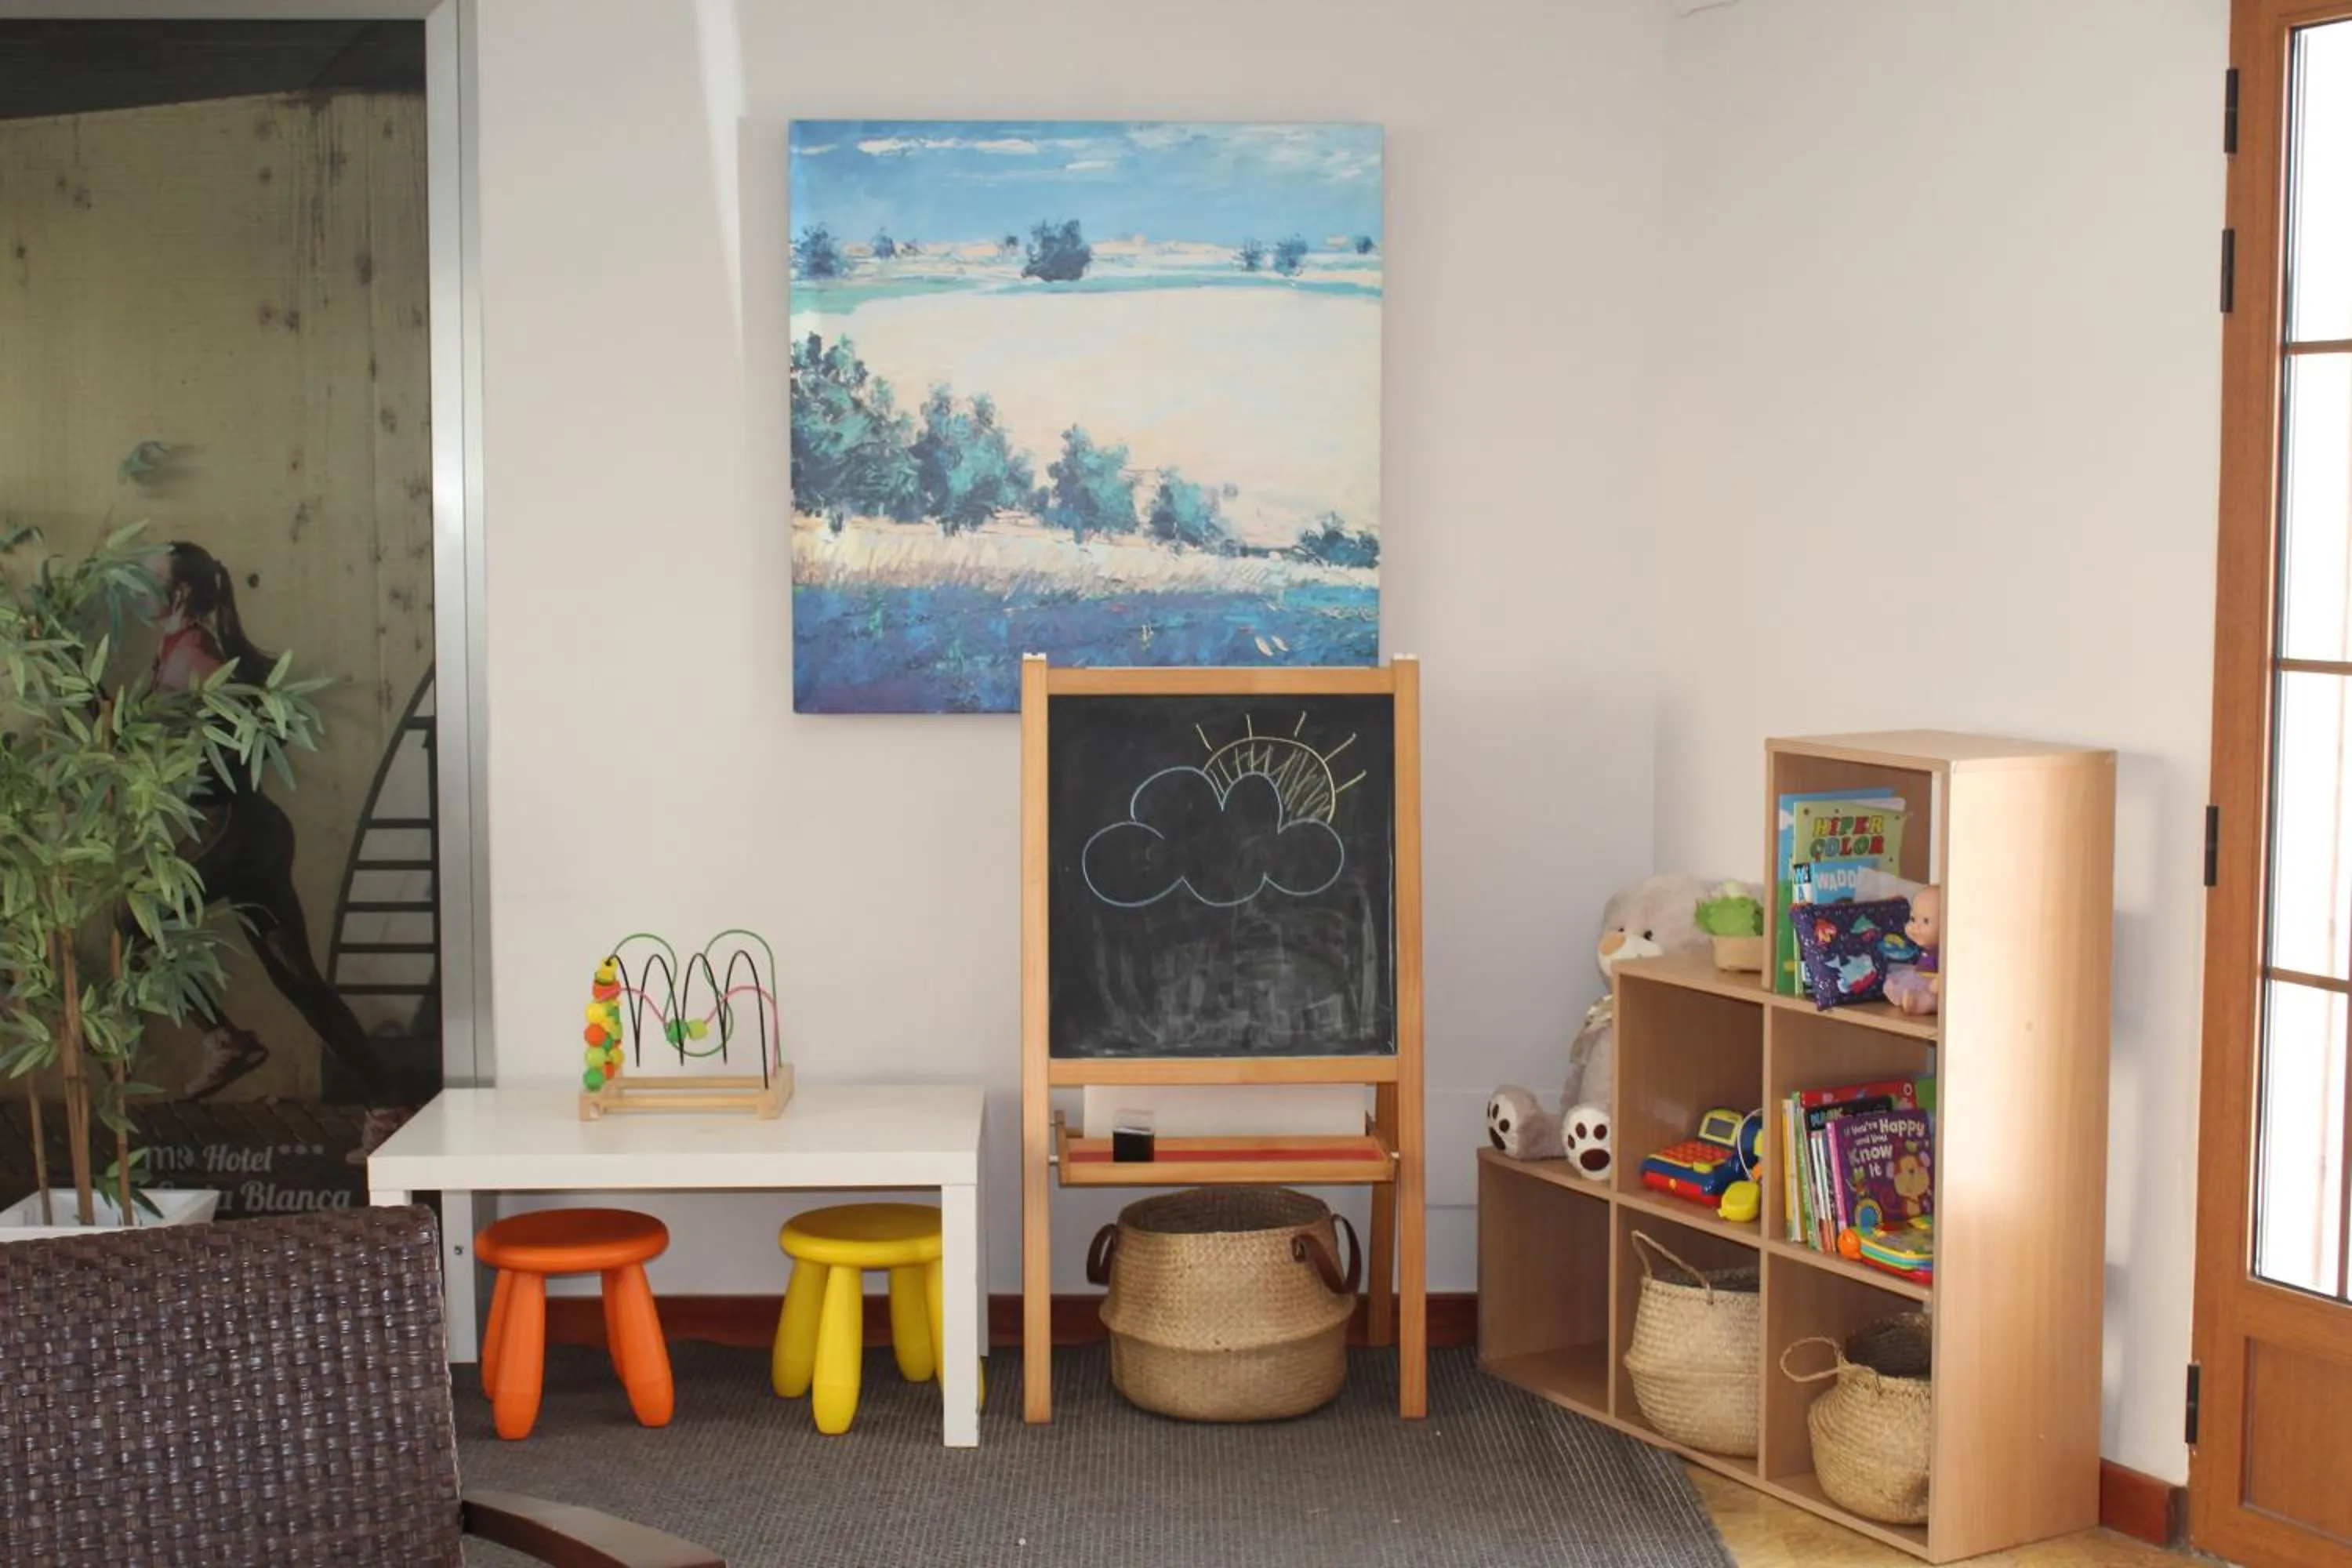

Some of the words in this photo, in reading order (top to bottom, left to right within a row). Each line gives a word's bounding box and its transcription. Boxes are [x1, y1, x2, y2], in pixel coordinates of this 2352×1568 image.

[1813, 815, 1884, 837] HIPER
[1809, 835, 1884, 858] COLOR
[1878, 1118, 1925, 1138] Happy
[202, 1144, 273, 1172] Hotel
[1847, 1145, 1893, 1165] Know
[239, 1180, 351, 1212] Blanca
